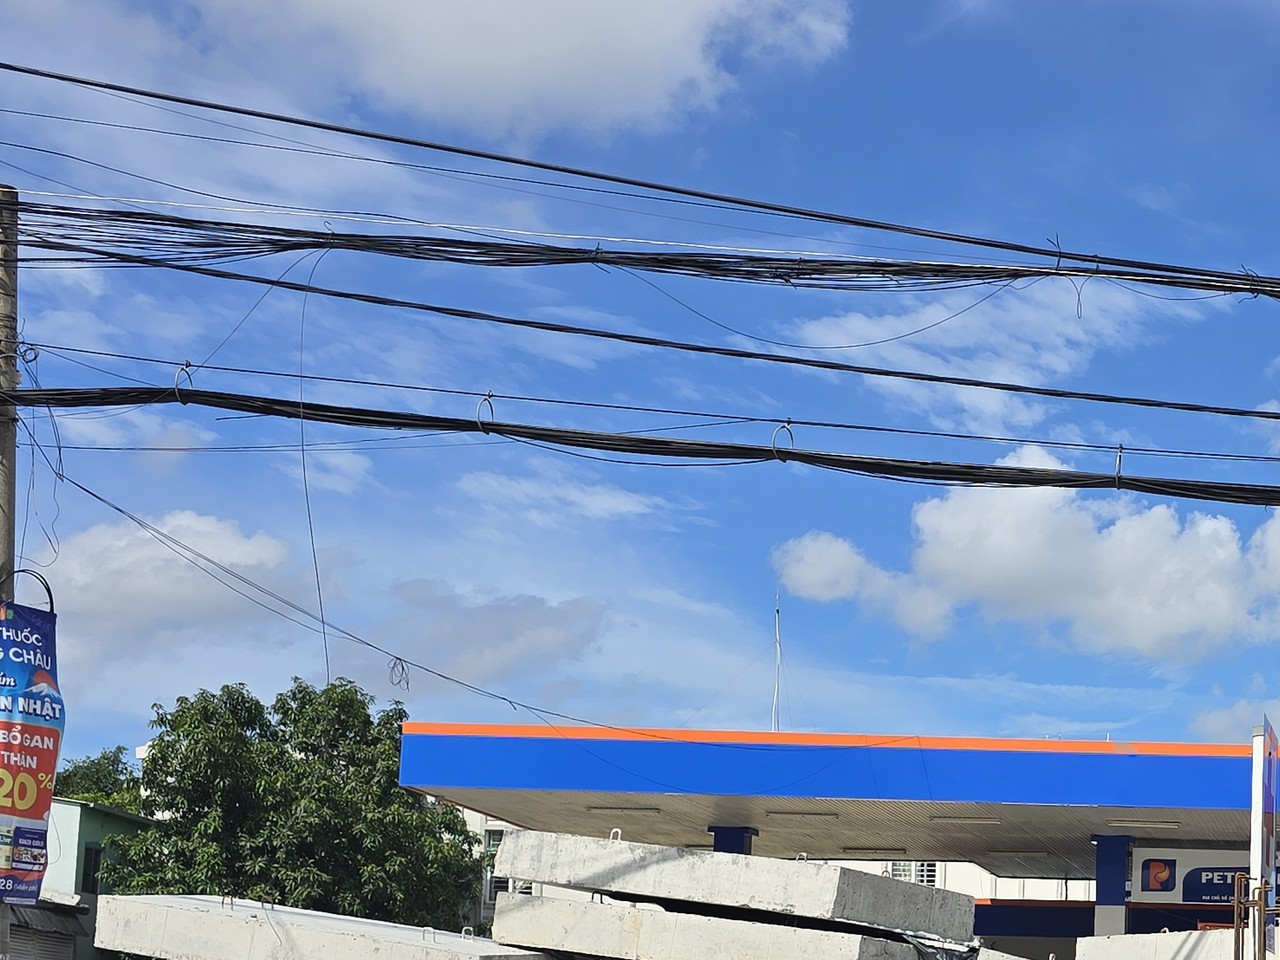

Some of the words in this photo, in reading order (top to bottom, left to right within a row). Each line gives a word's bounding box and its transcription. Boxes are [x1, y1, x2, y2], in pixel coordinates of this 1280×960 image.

[9, 647, 51, 671] CHÂU
[18, 697, 61, 720] NHẬT
[23, 734, 54, 750] GAN
